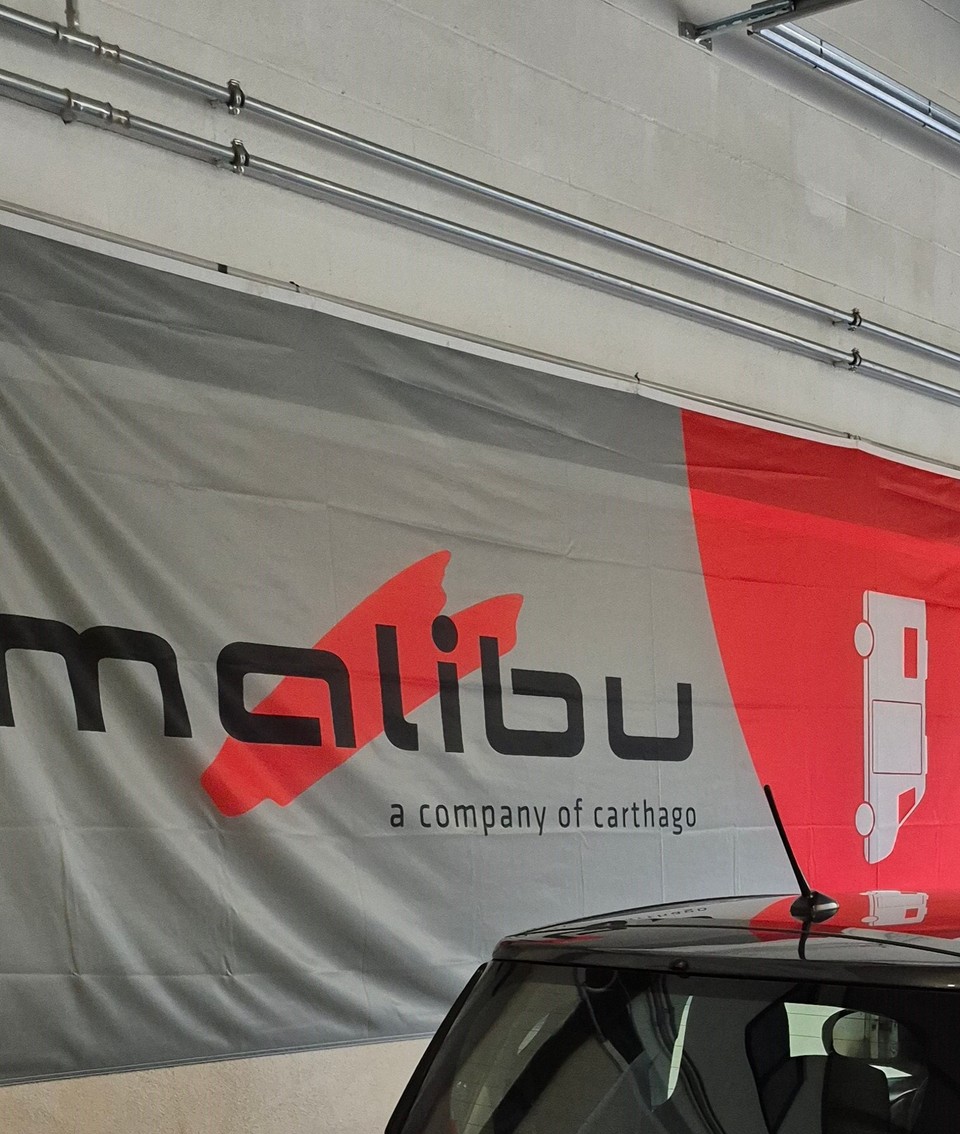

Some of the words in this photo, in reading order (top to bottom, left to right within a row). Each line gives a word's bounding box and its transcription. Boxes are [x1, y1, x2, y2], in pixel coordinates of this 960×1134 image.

[0, 613, 694, 762] malibu
[390, 803, 404, 828] a
[419, 803, 546, 836] company
[558, 798, 583, 828] of
[594, 799, 697, 835] carthago
